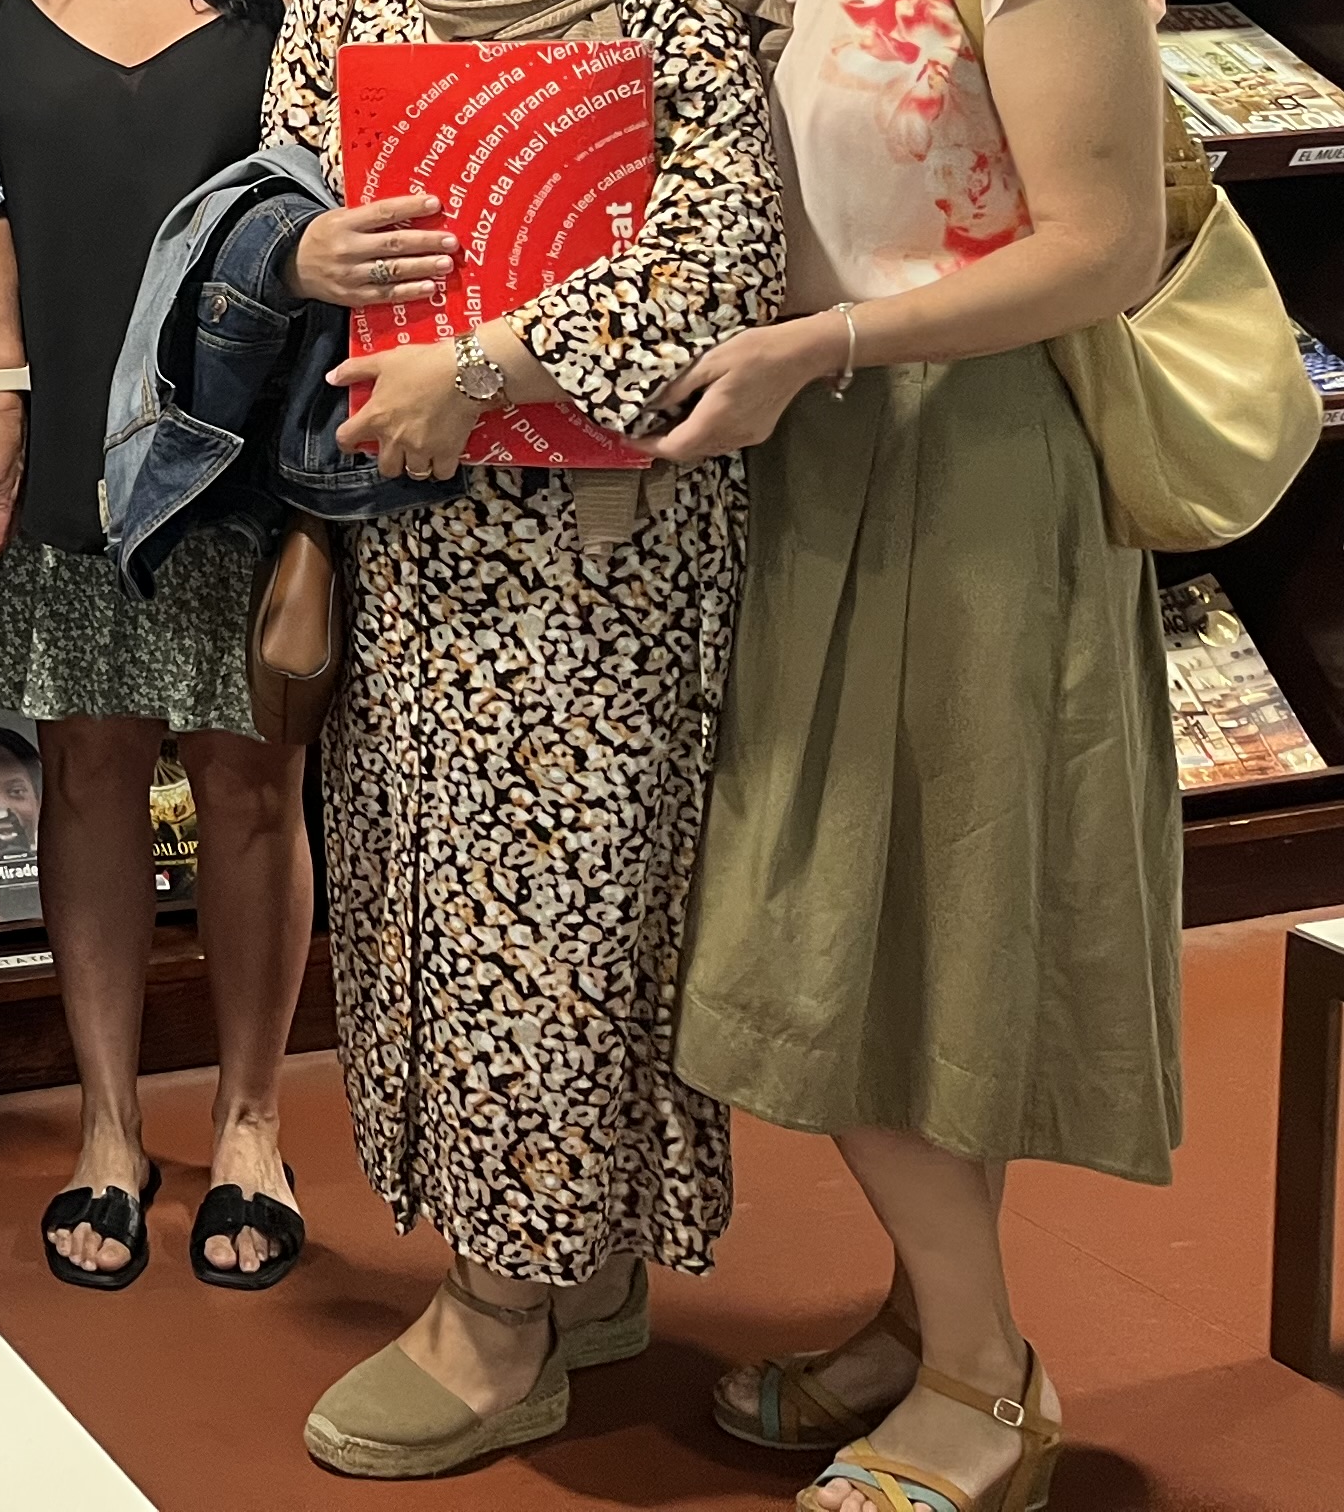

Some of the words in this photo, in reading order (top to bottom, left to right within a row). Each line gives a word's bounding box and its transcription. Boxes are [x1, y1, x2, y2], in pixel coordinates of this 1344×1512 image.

[537, 43, 579, 65] Ven
[392, 120, 410, 135] le
[405, 72, 460, 119] Catalan
[461, 124, 509, 183] catalan
[502, 81, 561, 131] jarana
[465, 209, 497, 267] Zatoz
[488, 175, 514, 206] eta
[504, 130, 549, 175] ikasi
[543, 79, 646, 138] katalanez
[546, 230, 569, 259] kom
[563, 212, 579, 230] en
[572, 188, 598, 213] leer
